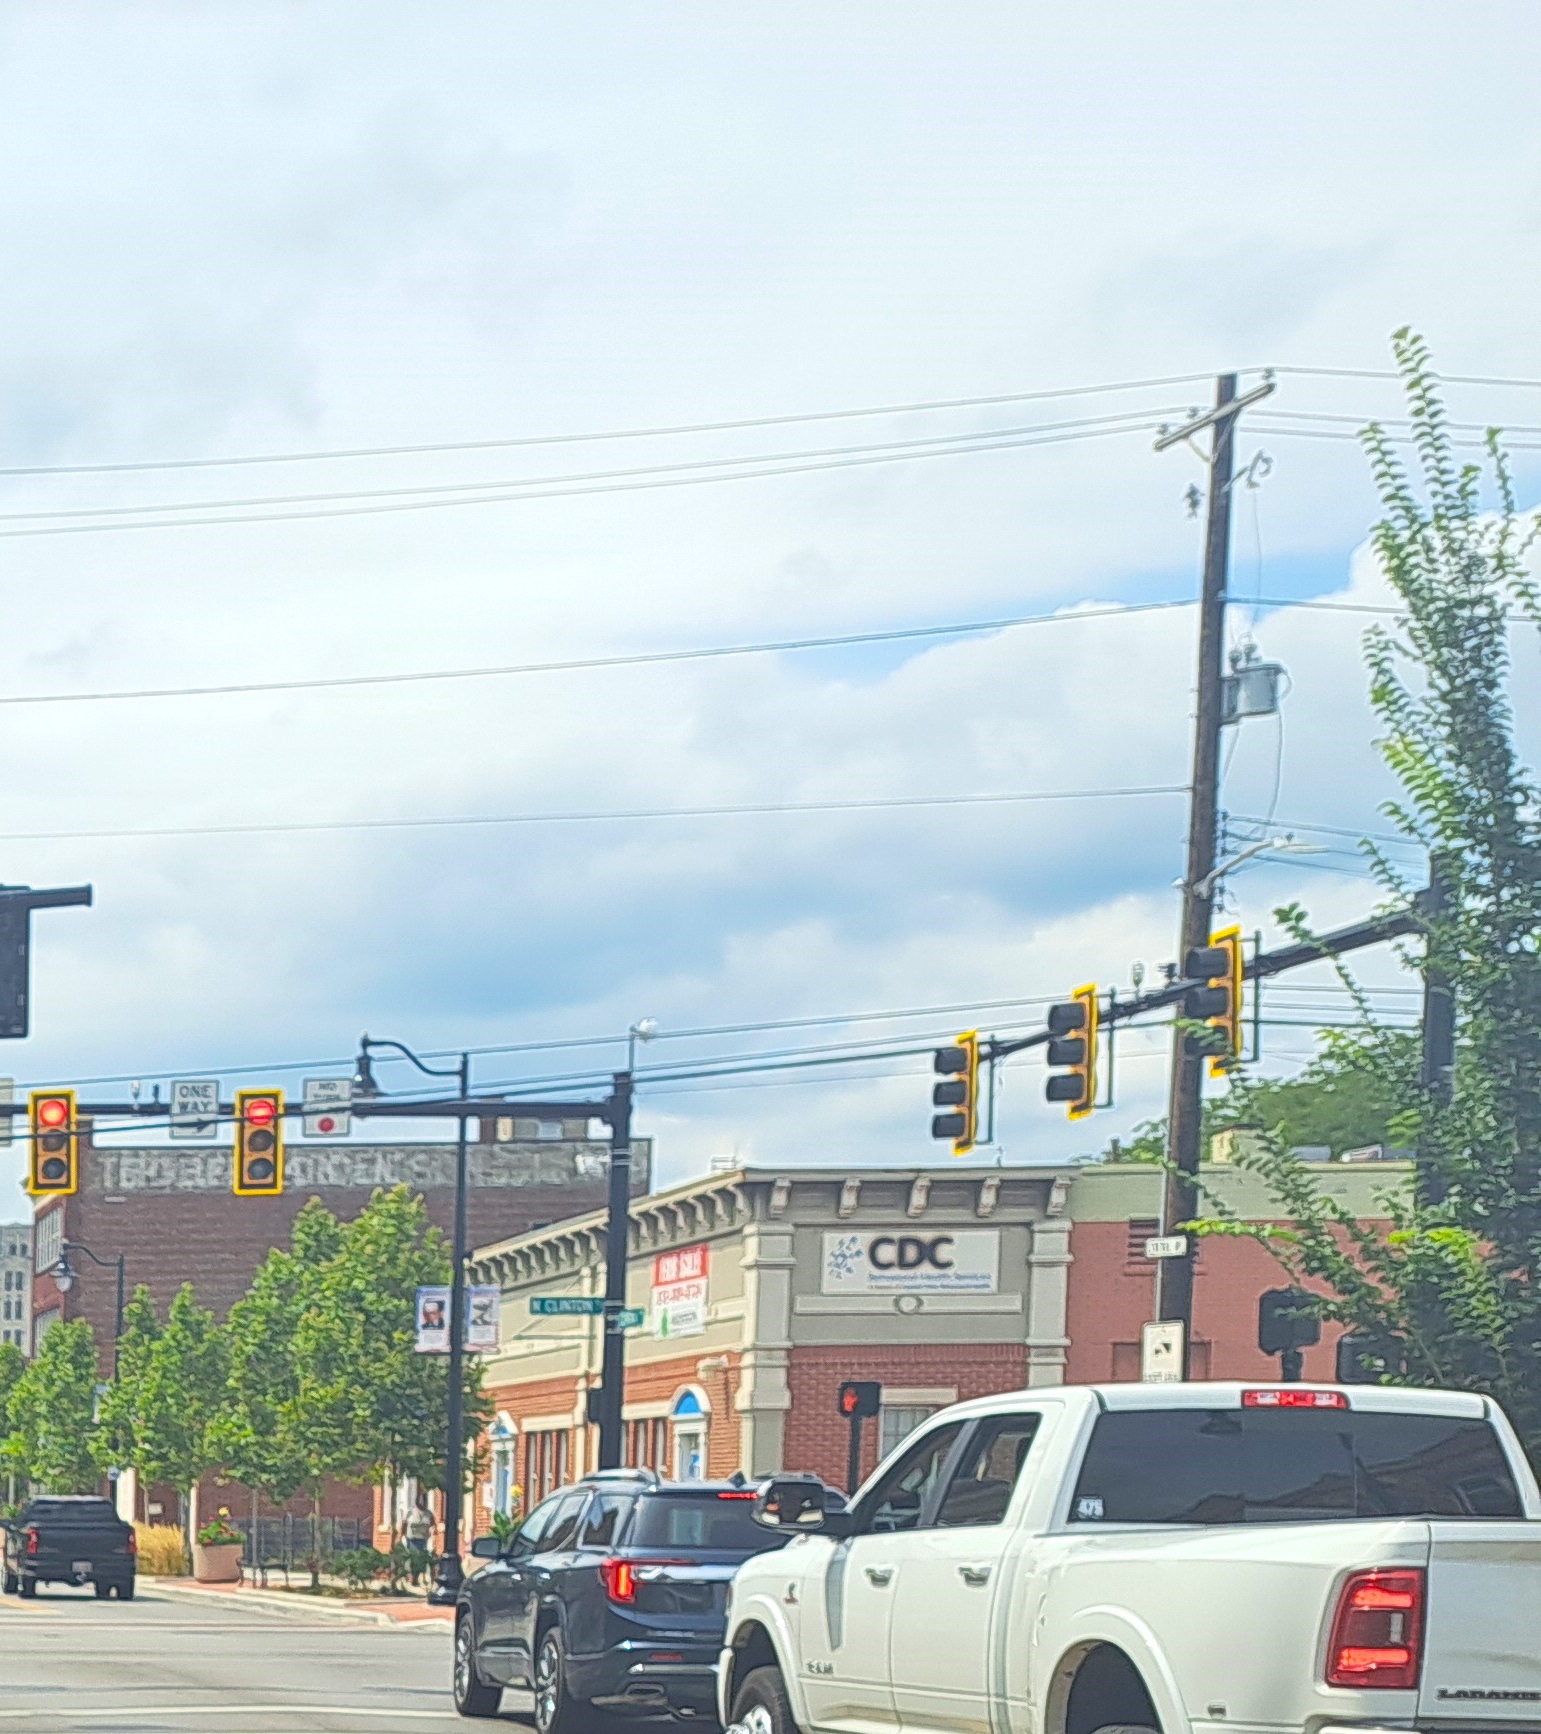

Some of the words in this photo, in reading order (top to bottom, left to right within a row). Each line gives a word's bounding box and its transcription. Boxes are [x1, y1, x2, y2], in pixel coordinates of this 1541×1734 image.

[179, 1085, 213, 1098] ONE
[179, 1101, 214, 1113] WAY
[868, 1236, 955, 1270] CDC
